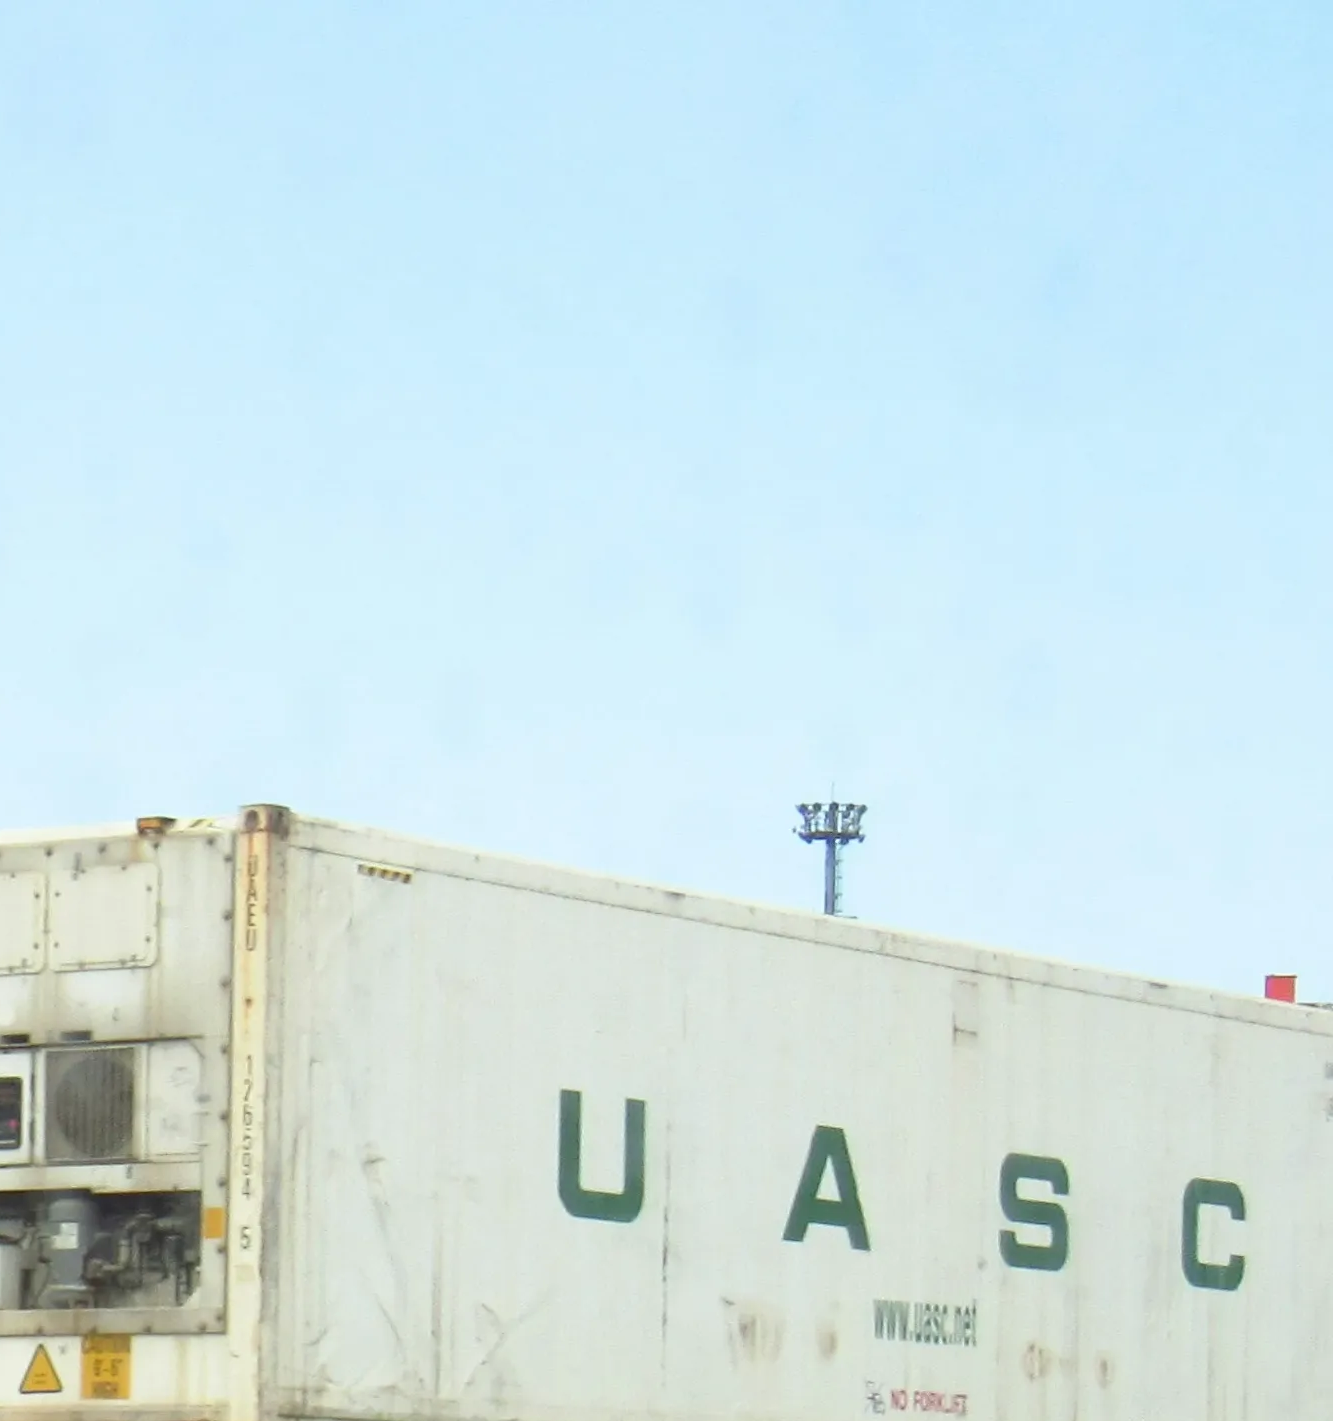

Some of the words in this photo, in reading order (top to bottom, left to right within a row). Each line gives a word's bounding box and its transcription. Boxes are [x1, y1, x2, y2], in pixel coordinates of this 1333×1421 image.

[557, 1087, 1247, 1292] UASC
[873, 1298, 978, 1348] www.uasc.net
[890, 1389, 908, 1411] NO
